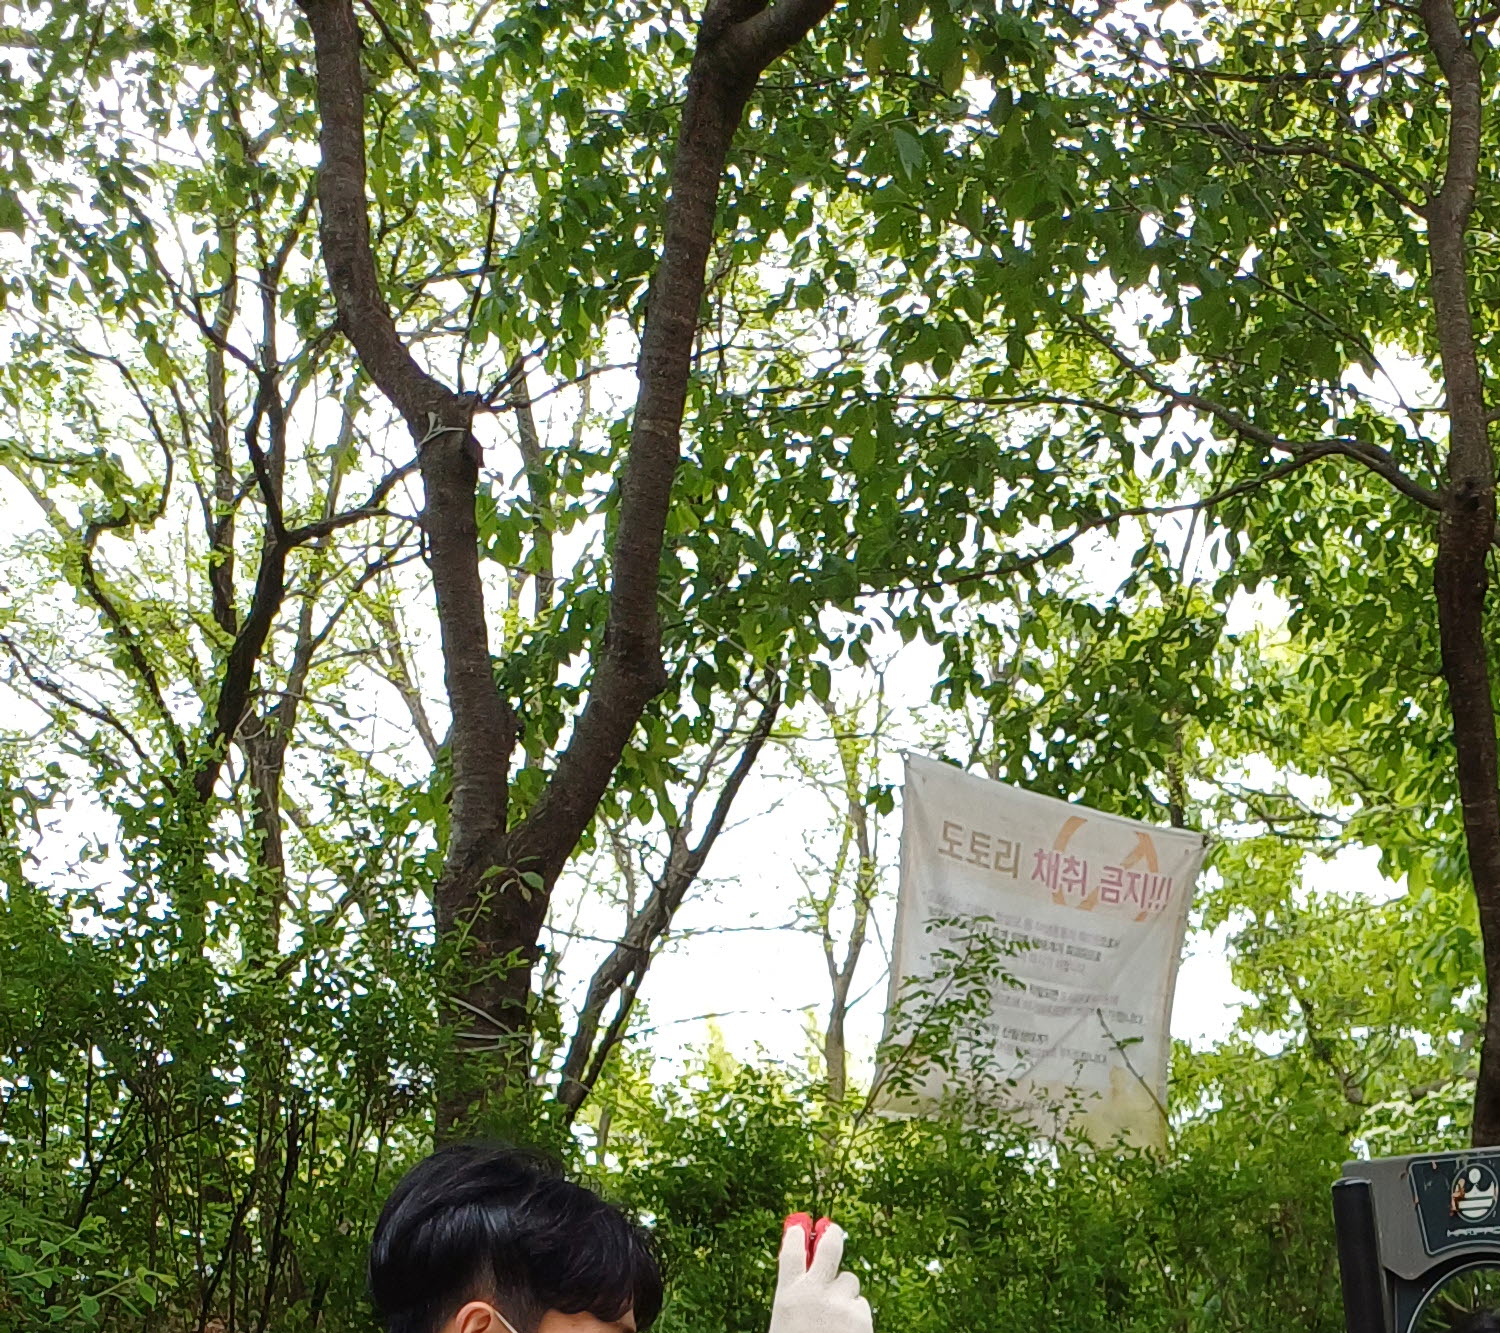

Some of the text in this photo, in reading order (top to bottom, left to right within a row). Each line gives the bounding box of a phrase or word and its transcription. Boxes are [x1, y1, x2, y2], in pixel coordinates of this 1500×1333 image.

[937, 820, 1173, 912] 도토리 채취 금지!!!
